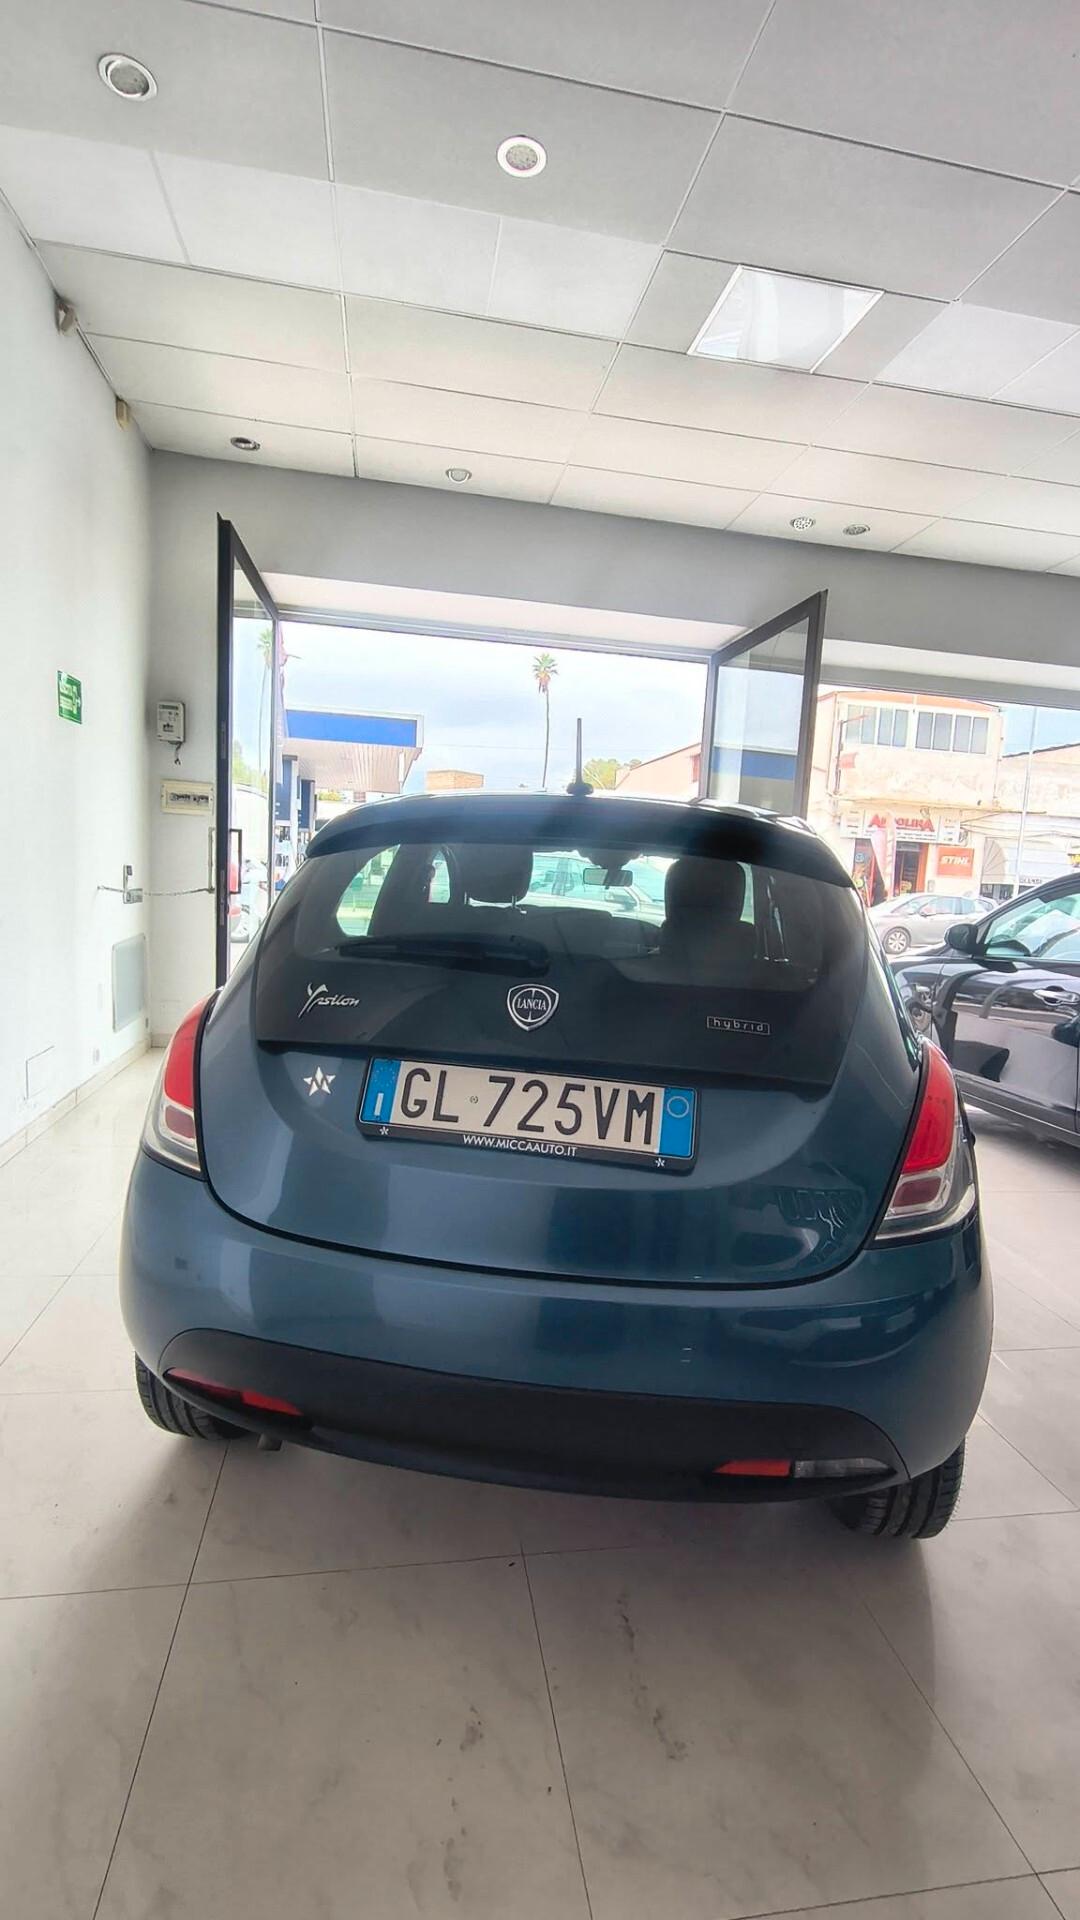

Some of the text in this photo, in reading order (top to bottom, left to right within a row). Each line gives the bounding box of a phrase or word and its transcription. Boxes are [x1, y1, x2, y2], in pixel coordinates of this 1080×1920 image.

[298, 983, 360, 1018] Ypsilon
[517, 998, 547, 1010] LANCIA
[713, 1017, 764, 1031] hybrid
[401, 1068, 459, 1123] GL
[483, 1075, 655, 1145] 725VM
[463, 1134, 578, 1157] WWW.MICCAAUTO.IT
